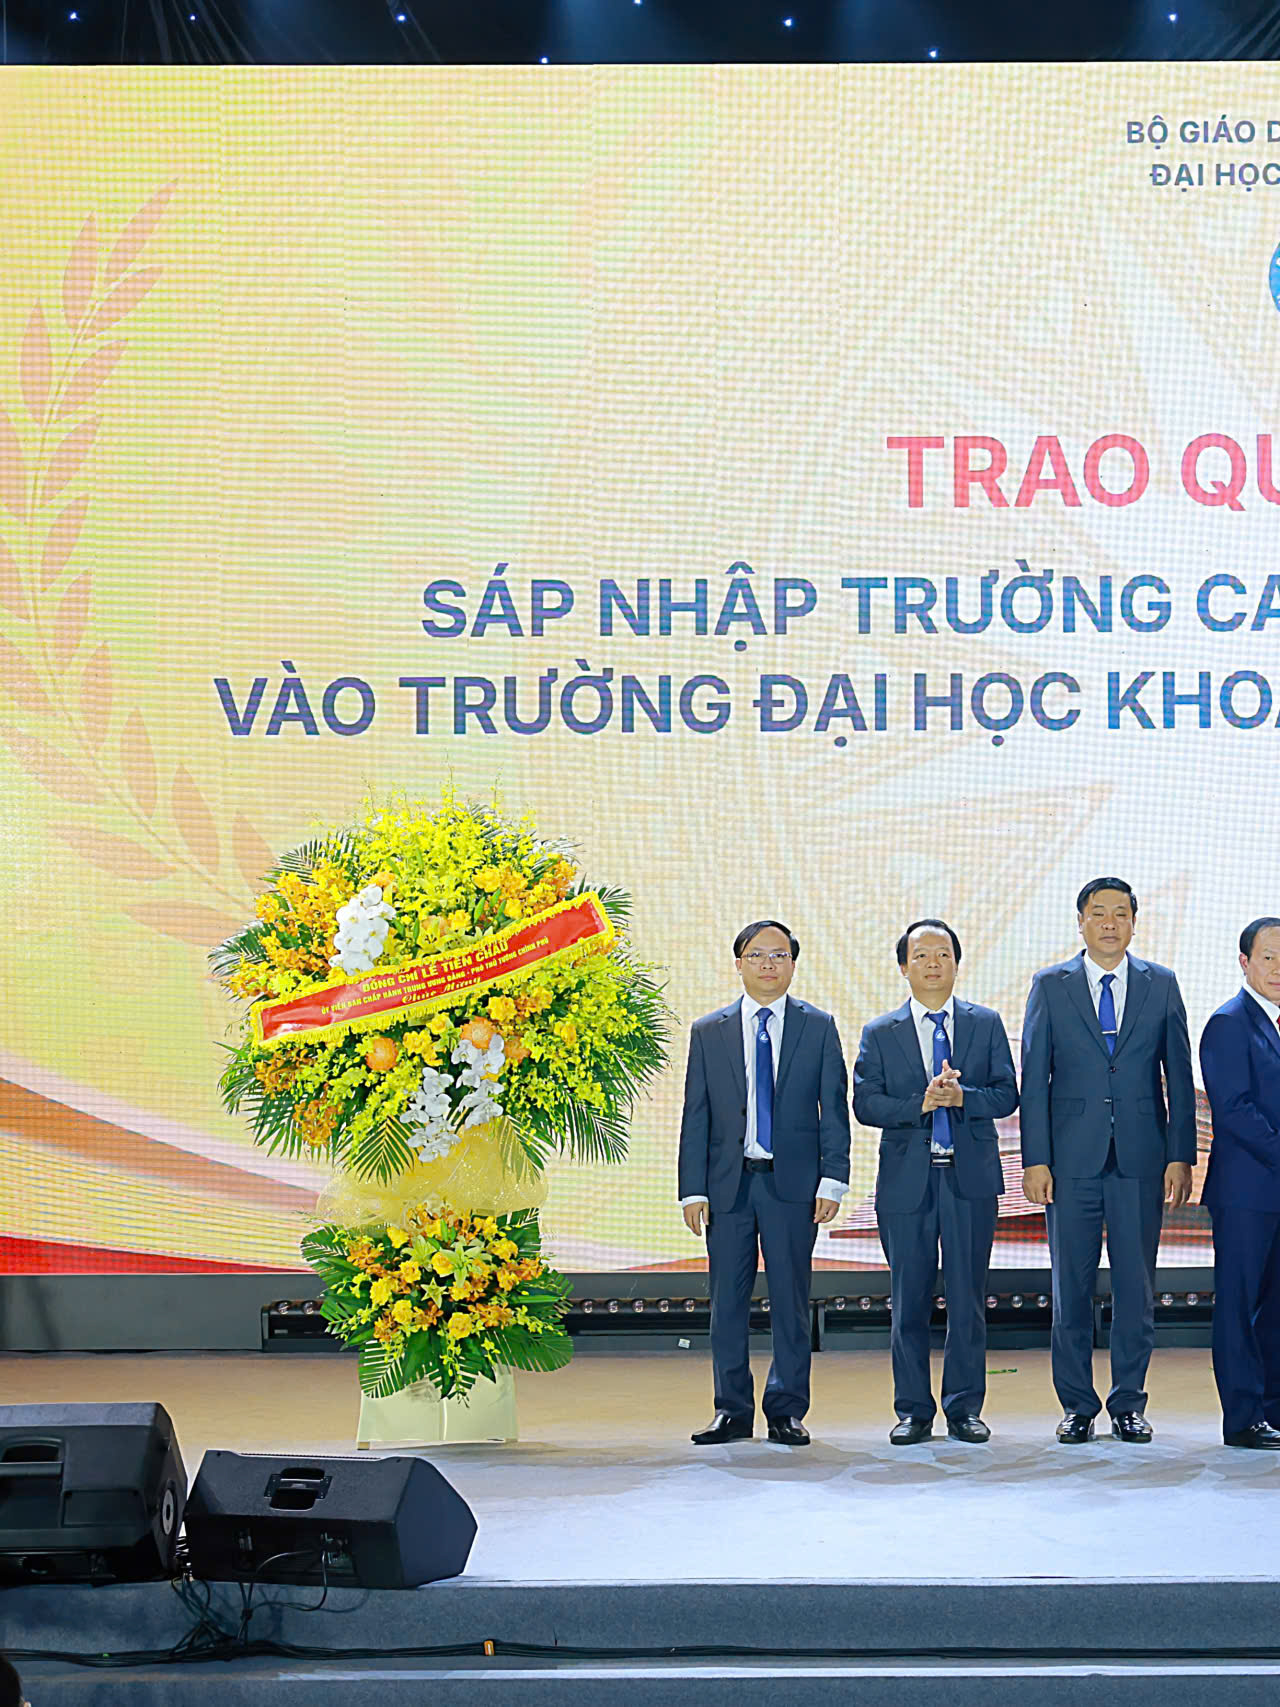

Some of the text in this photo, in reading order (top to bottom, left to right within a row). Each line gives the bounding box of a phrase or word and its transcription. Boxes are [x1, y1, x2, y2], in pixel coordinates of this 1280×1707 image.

[1127, 115, 1168, 149] BỘ
[1180, 114, 1256, 143] GIÁO
[1149, 163, 1204, 192] ĐẠI
[887, 434, 1150, 509] TRAO
[421, 562, 574, 638] SÁP
[599, 561, 818, 652] NHẬP
[841, 559, 1172, 635] TRƯỜNG
[213, 660, 376, 737] VÀO
[398, 658, 731, 736] TRƯỜNG
[753, 673, 887, 748] ĐẠI
[914, 671, 1081, 747] HỌC
